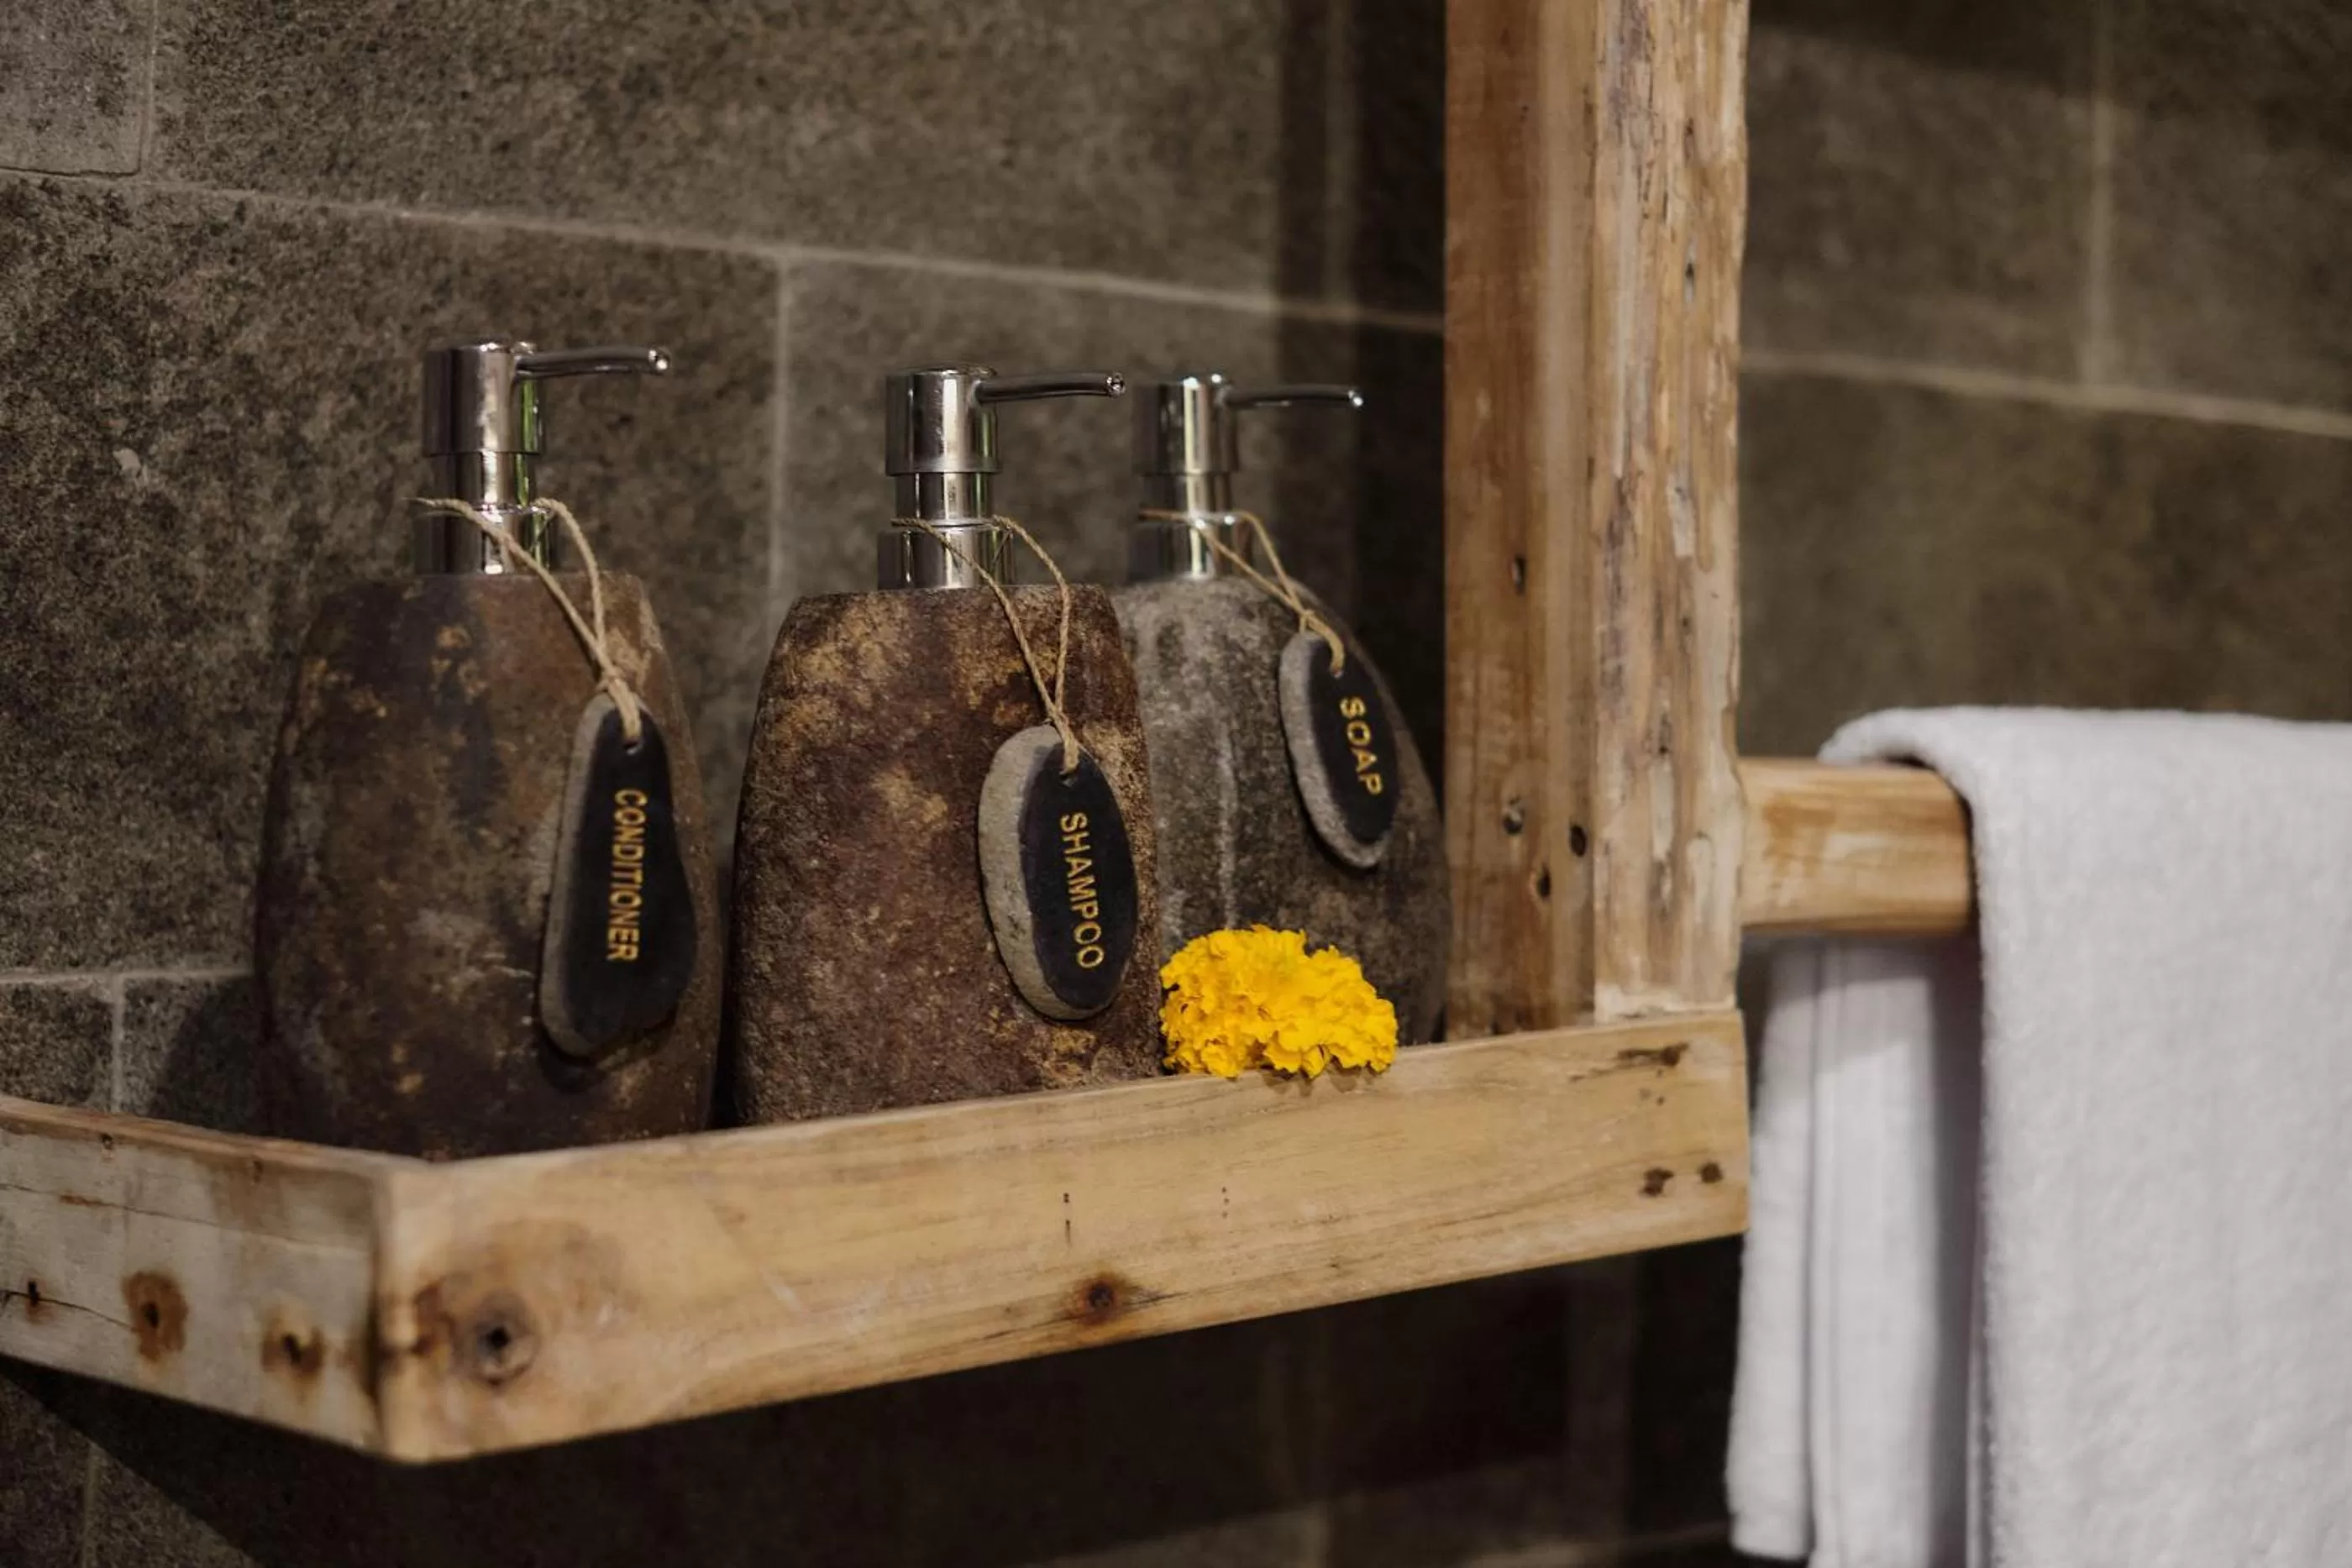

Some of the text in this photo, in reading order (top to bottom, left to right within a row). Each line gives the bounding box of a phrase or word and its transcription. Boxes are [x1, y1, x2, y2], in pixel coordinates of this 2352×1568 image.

[1340, 696, 1383, 795] SOAP
[606, 789, 648, 962] CONDITIONER
[1059, 811, 1105, 968] SHAMPOO
